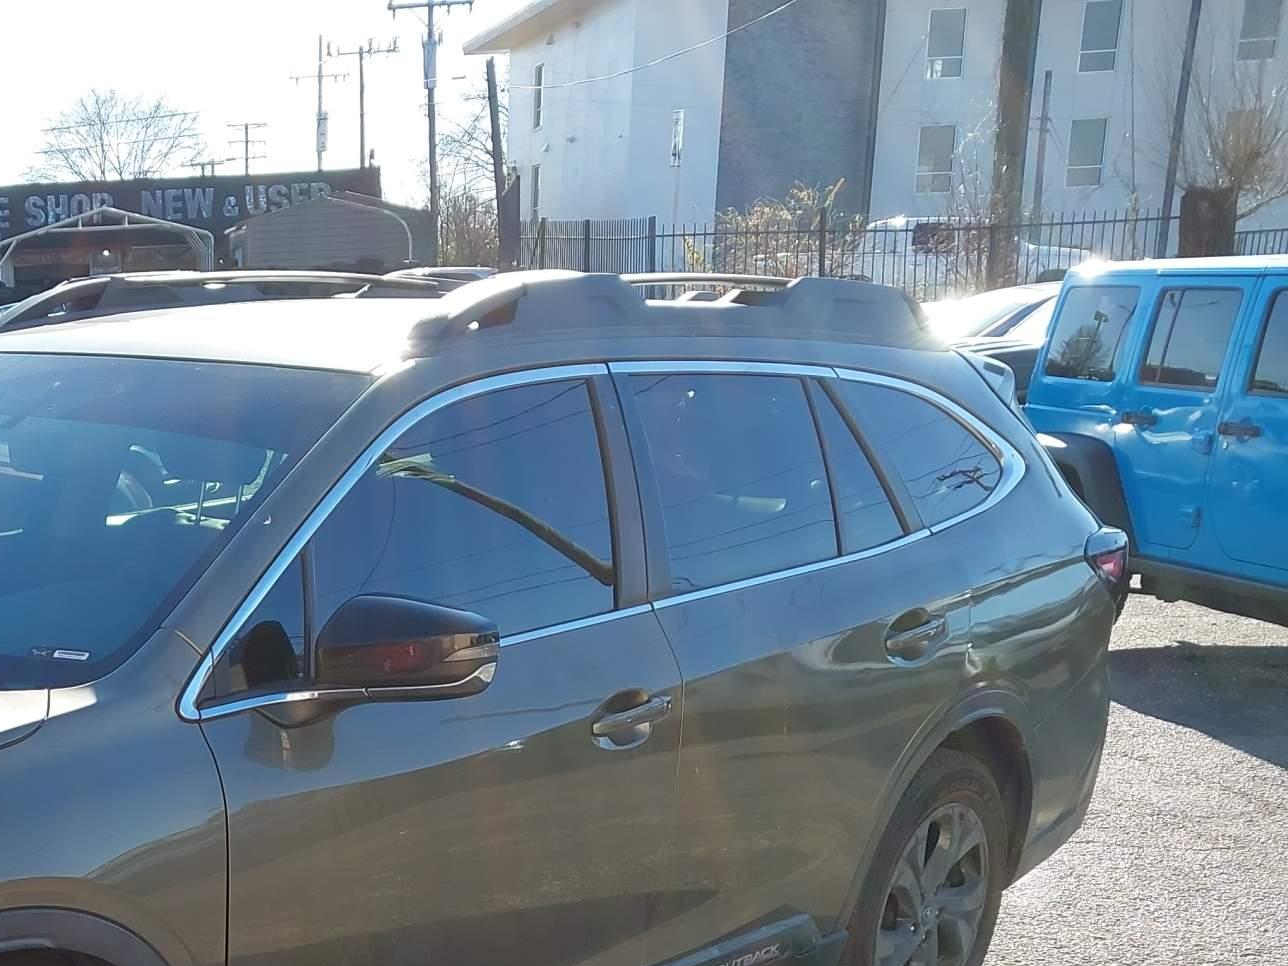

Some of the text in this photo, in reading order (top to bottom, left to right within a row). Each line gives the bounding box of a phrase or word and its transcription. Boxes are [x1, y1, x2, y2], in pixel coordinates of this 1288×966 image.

[24, 193, 114, 227] SHOP
[141, 188, 214, 220] NEW
[222, 195, 239, 216] &
